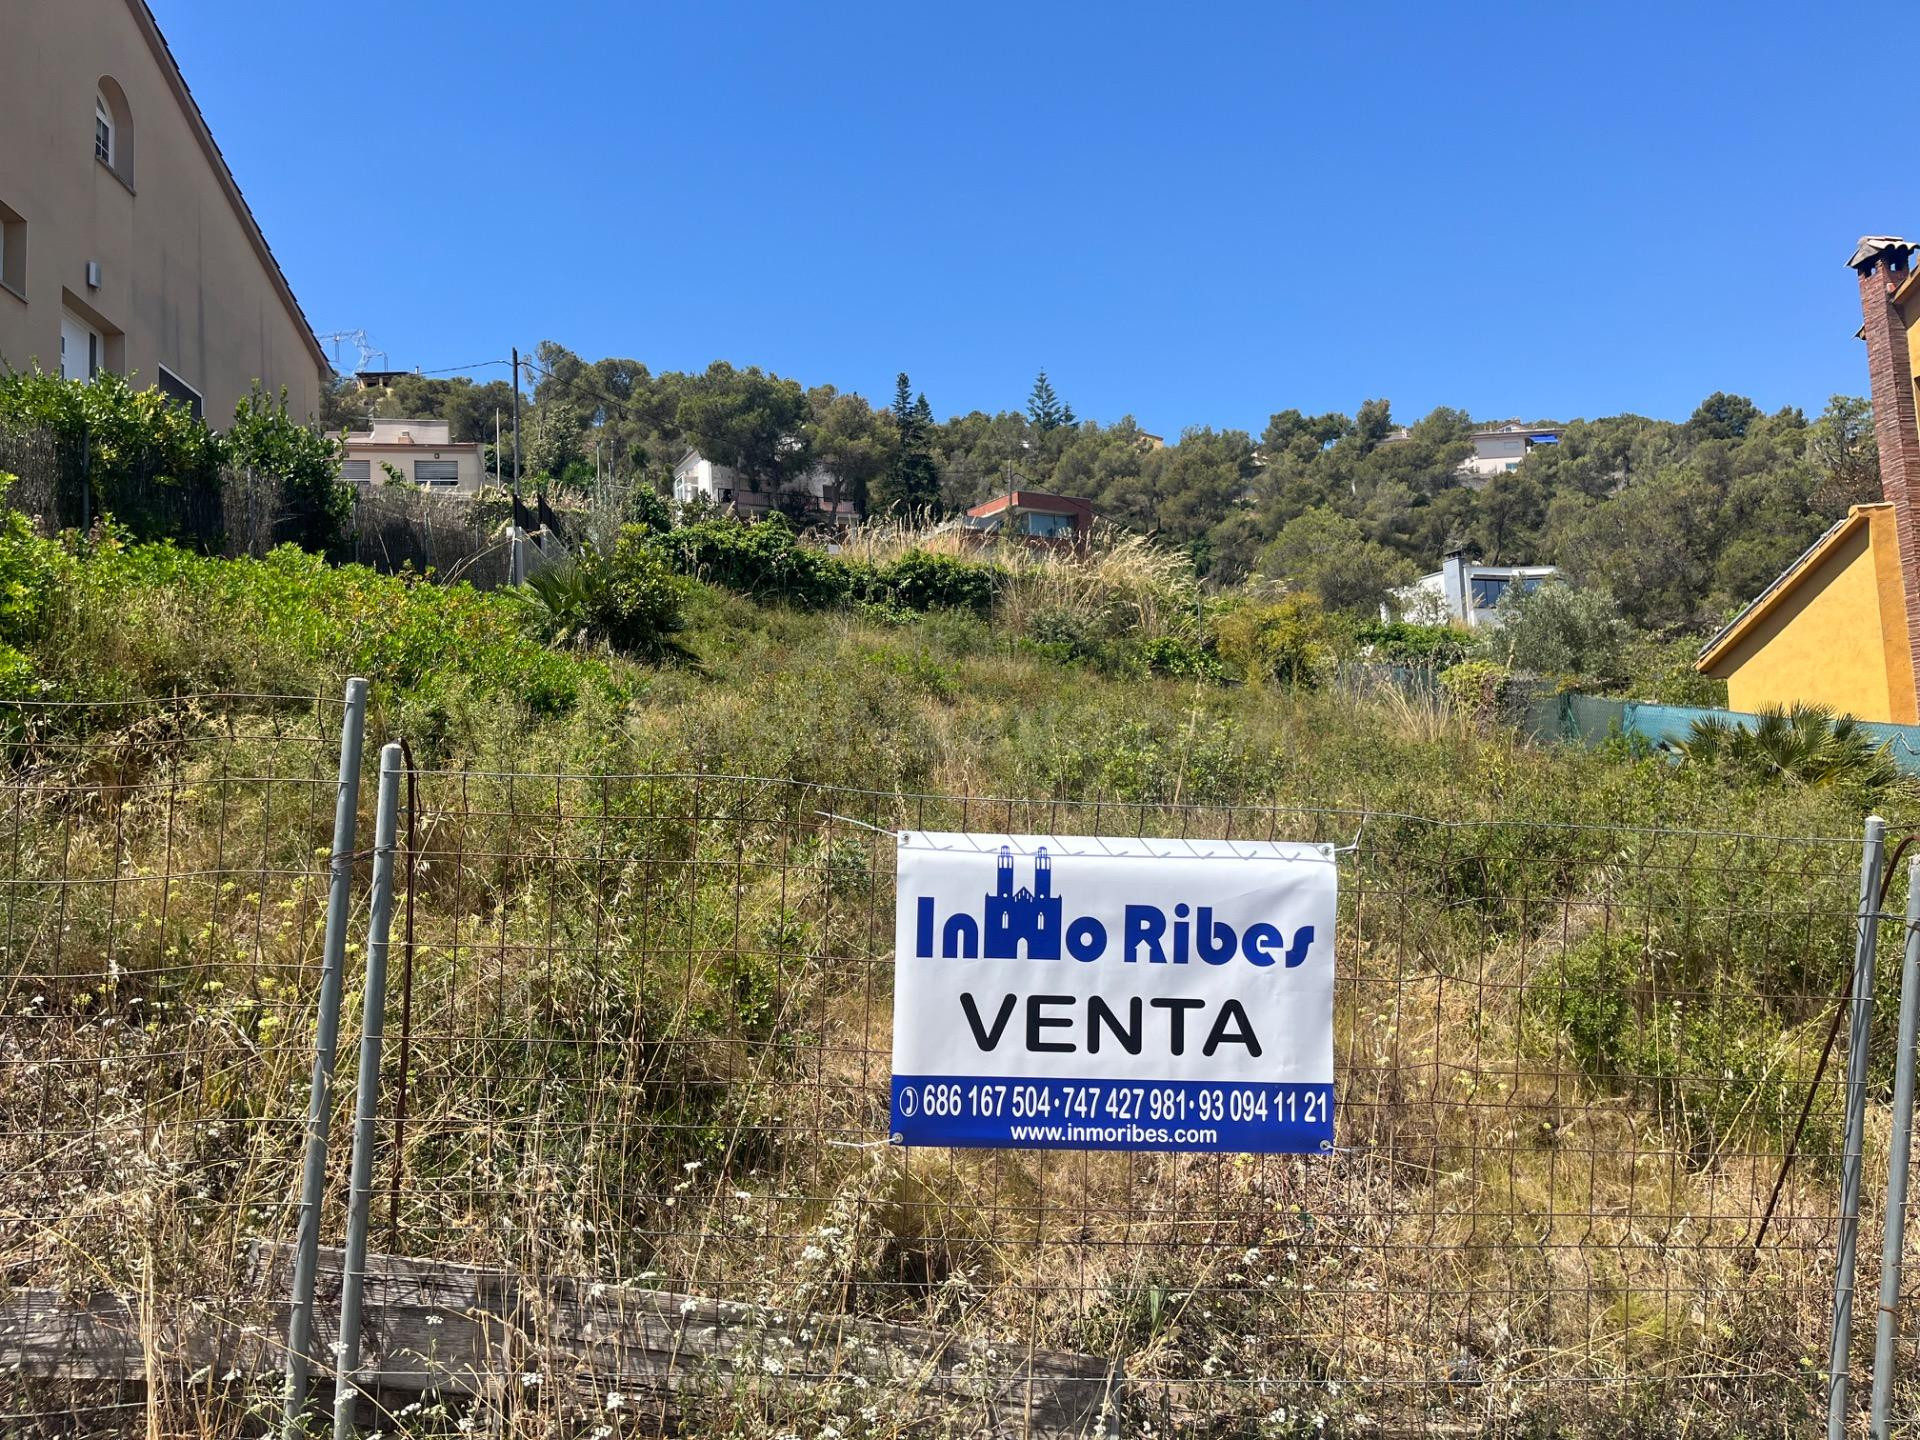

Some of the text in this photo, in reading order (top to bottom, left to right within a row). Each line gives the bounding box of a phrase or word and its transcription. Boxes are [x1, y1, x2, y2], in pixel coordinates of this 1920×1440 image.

[1124, 903, 1315, 968] Ribes
[959, 992, 1263, 1058] VENTA
[923, 1084, 962, 1117] 686
[968, 1085, 1006, 1117] 167
[1105, 1088, 1144, 1120] 427
[1229, 1090, 1268, 1122] 094
[1274, 1091, 1297, 1122] 11
[1304, 1091, 1328, 1123] 21
[1010, 1123, 1217, 1144] www.inmoribes.com
